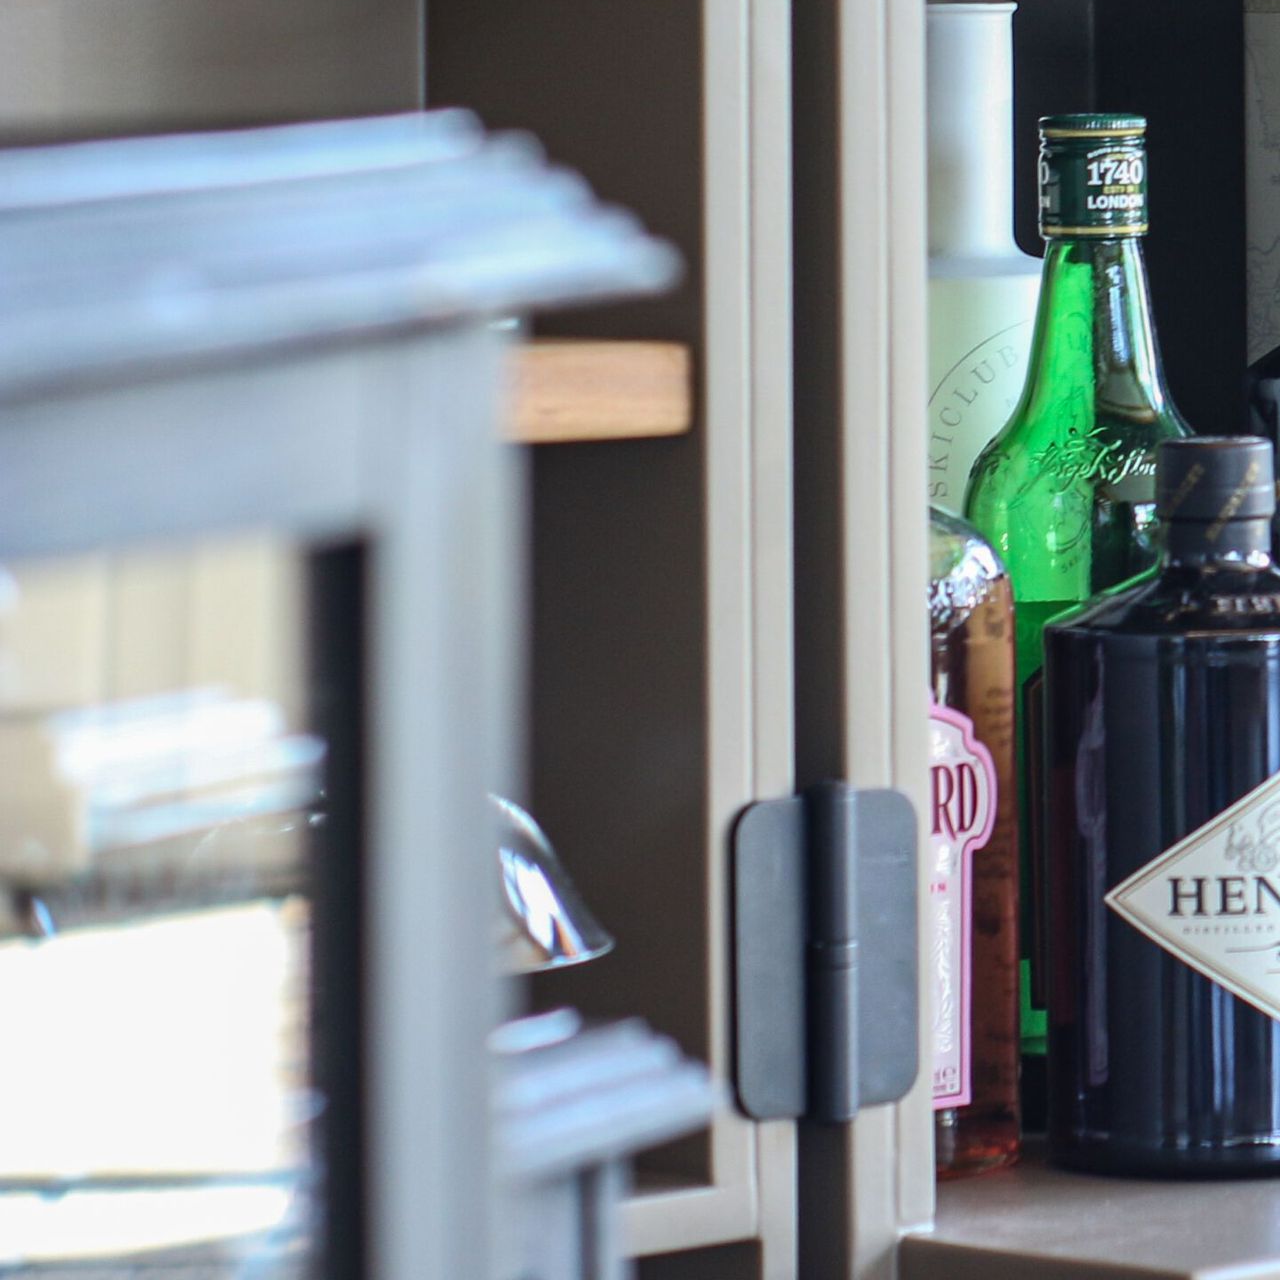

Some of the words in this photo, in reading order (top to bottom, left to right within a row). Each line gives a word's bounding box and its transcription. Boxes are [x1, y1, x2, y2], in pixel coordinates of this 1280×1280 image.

[1087, 159, 1144, 186] 1740
[1087, 194, 1144, 210] LONDON
[930, 762, 978, 841] RD
